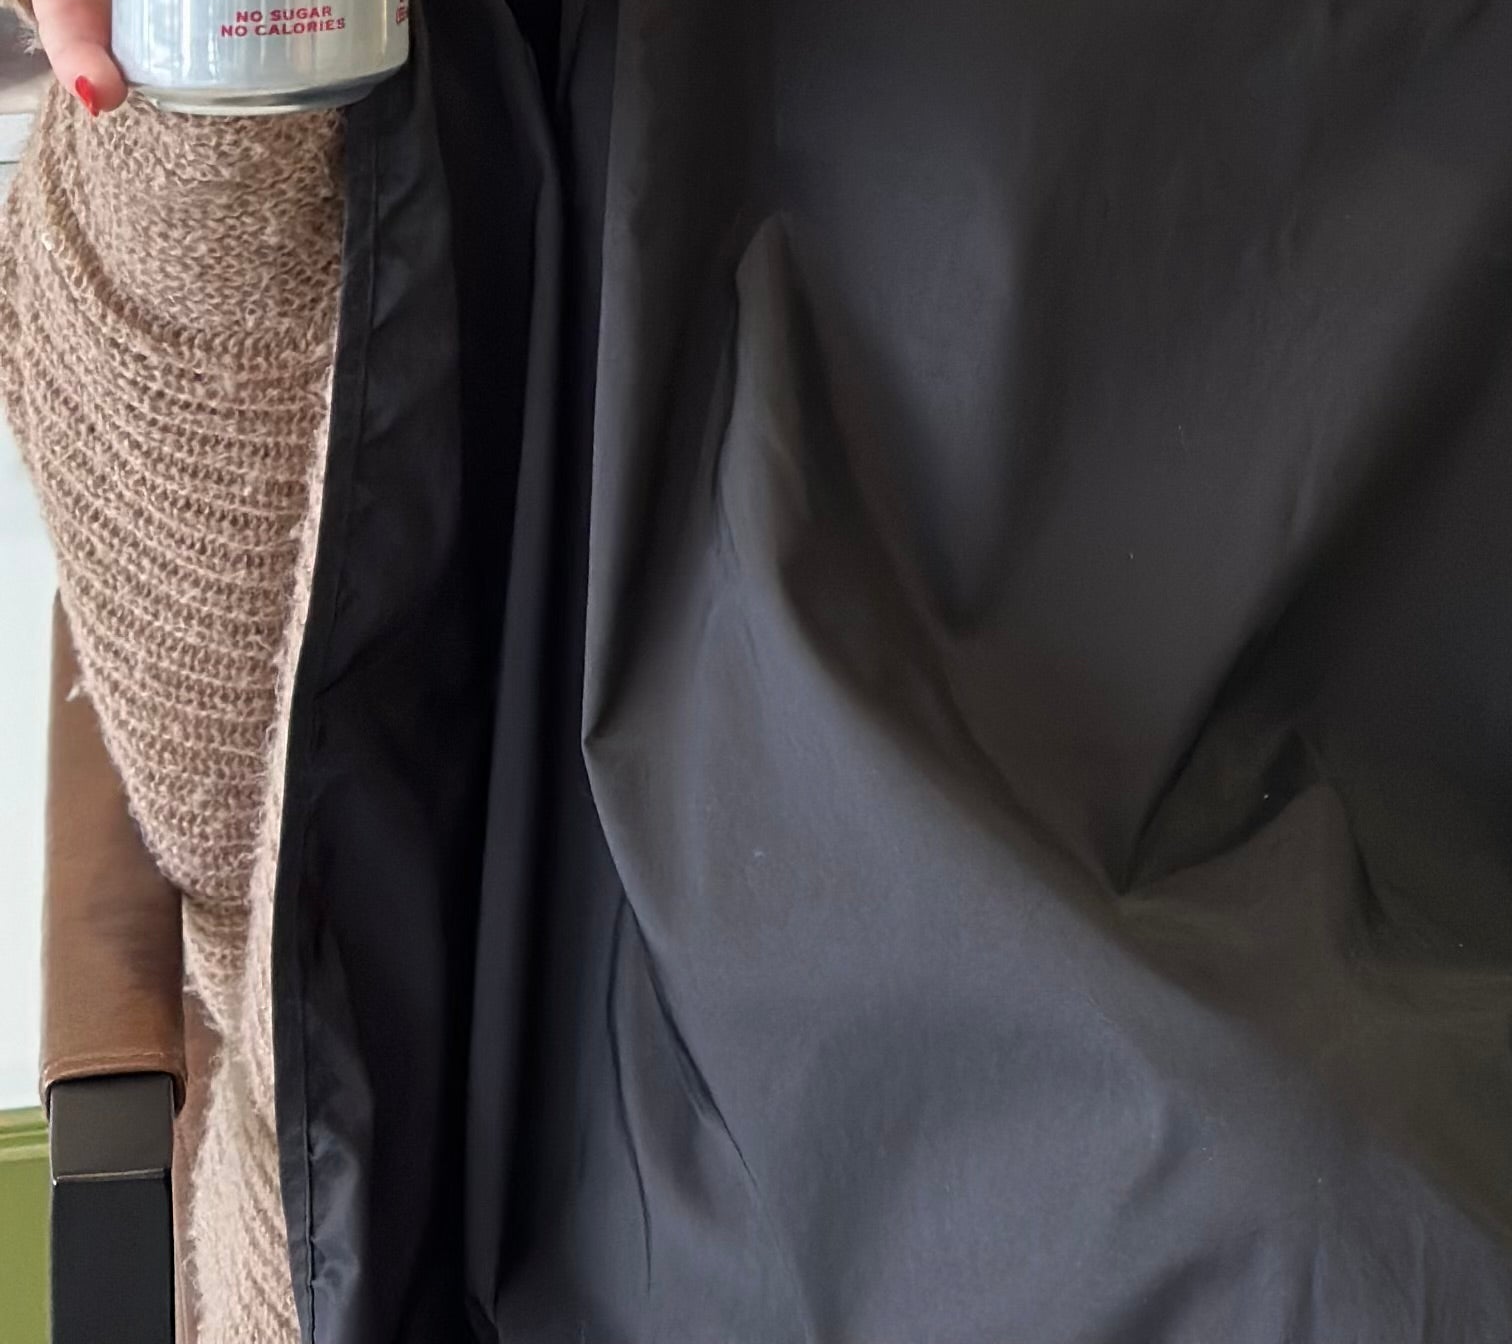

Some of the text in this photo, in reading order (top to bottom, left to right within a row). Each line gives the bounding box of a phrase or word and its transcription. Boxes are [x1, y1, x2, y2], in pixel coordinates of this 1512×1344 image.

[236, 6, 332, 23] NO SUGAR
[220, 17, 346, 37] NO CALORIES
